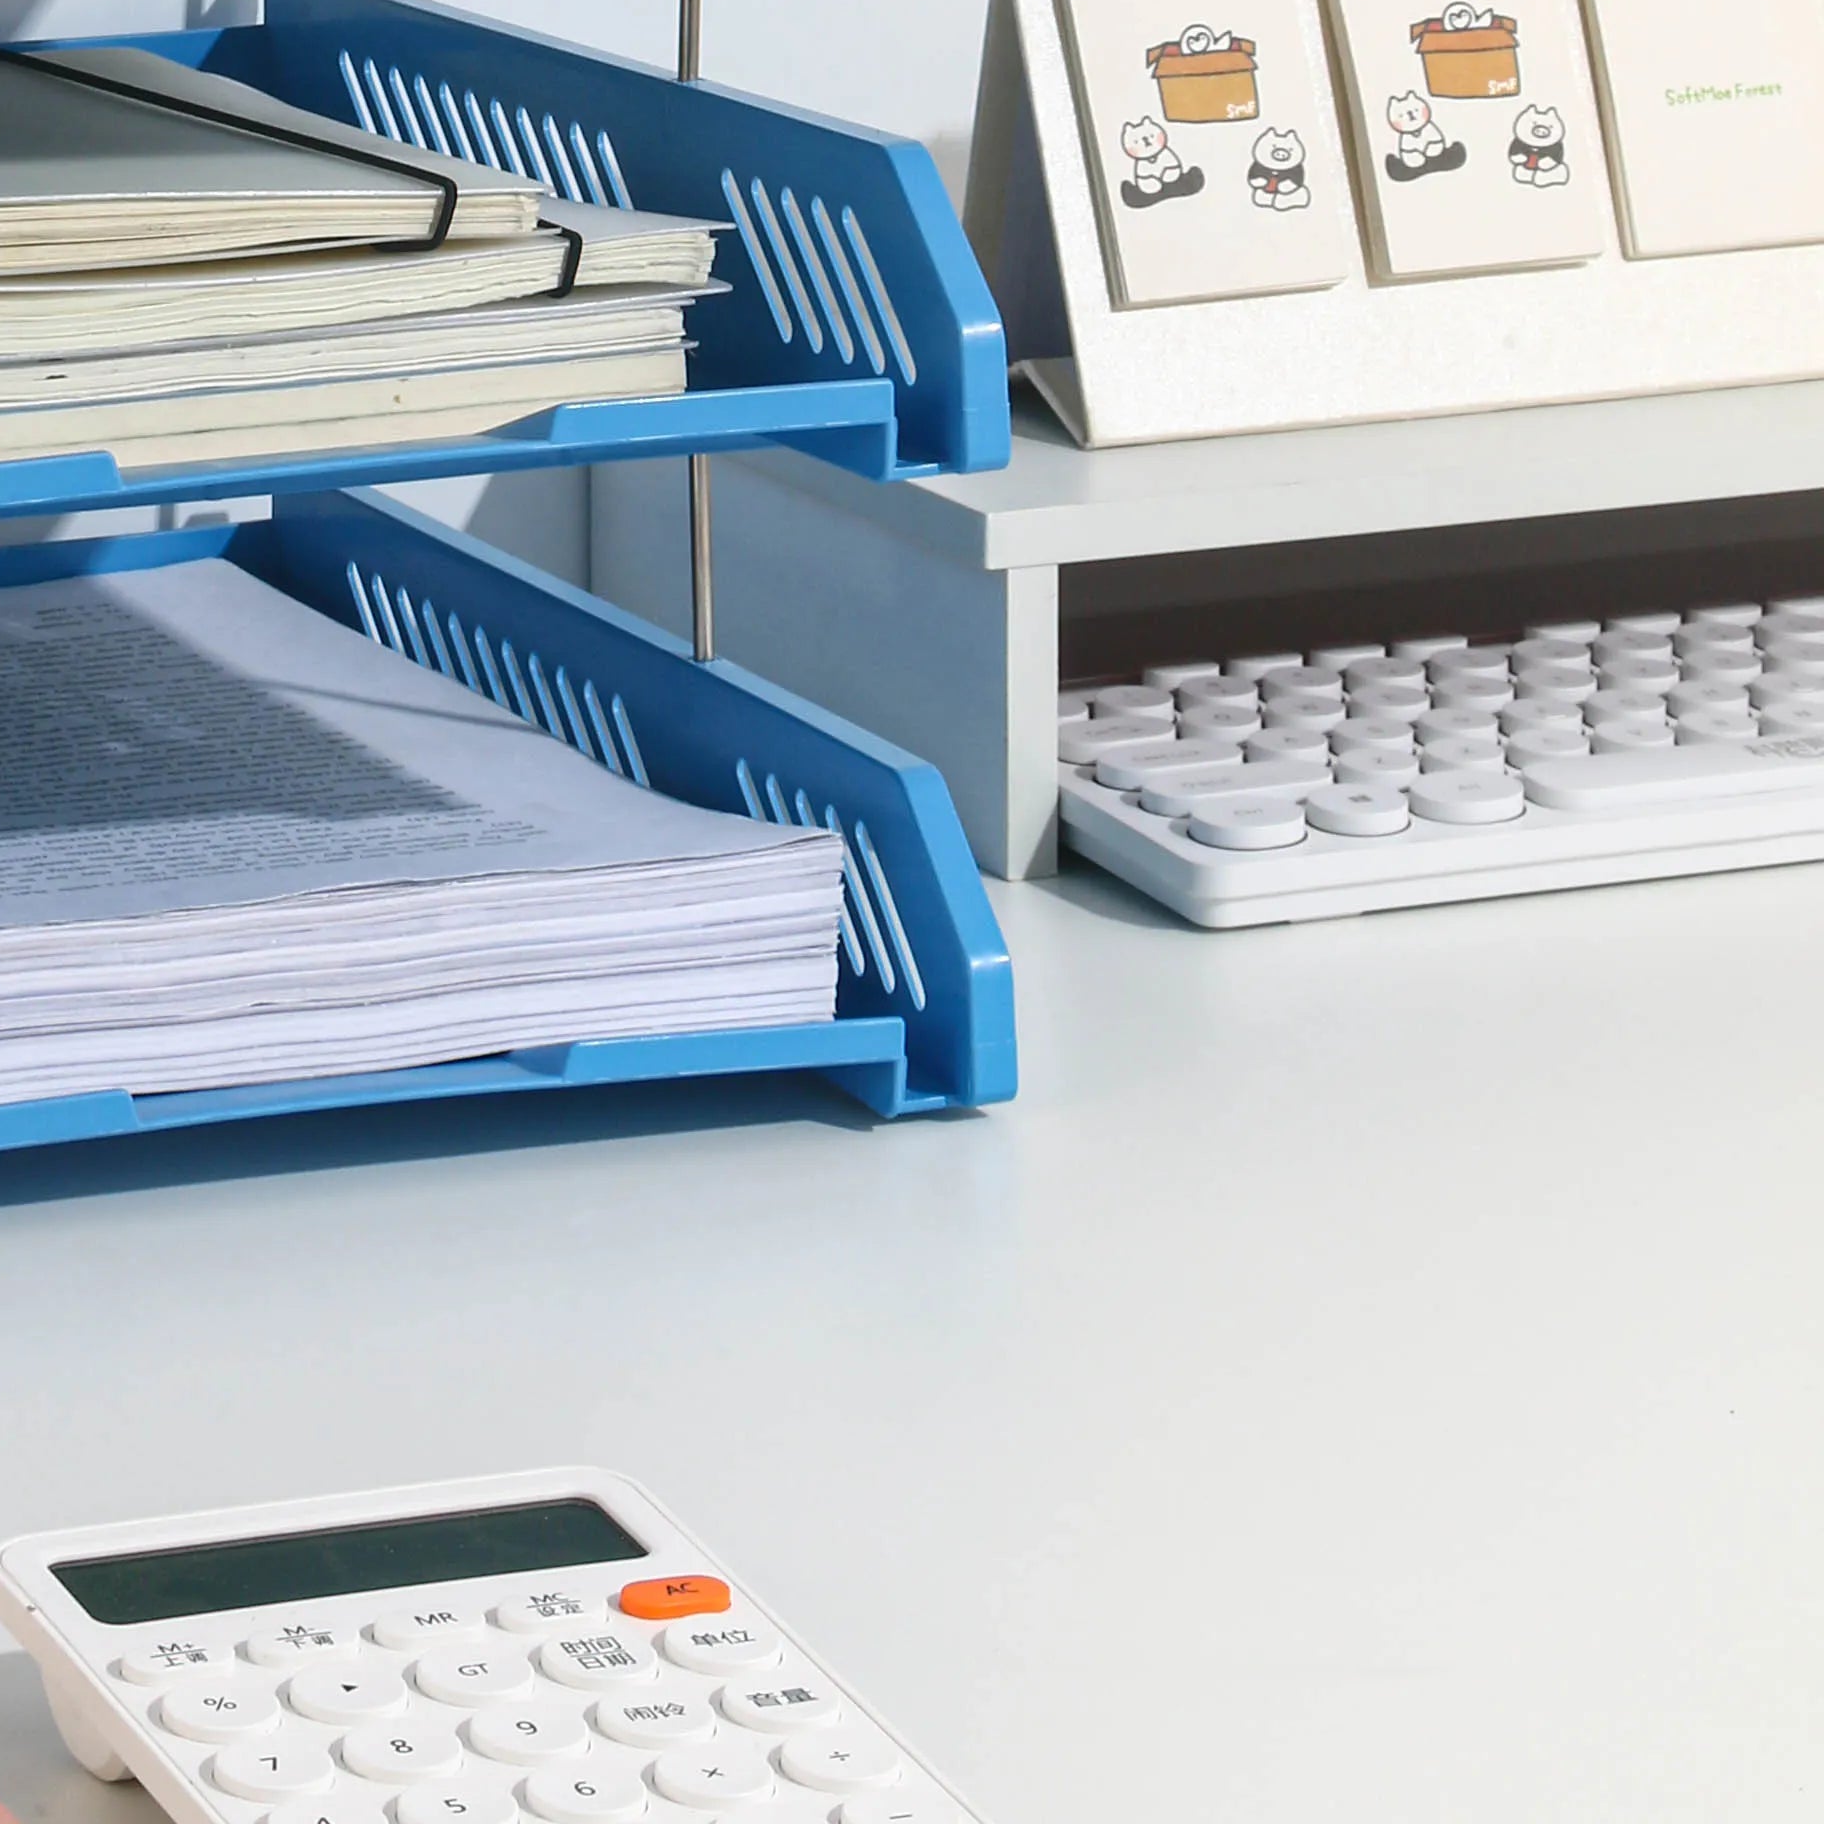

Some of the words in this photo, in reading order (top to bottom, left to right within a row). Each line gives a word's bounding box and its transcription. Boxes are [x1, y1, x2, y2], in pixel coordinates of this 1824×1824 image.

[1734, 82, 1782, 100] Forest
[665, 1582, 700, 1596] AC
[529, 1592, 568, 1605] MC
[413, 1611, 458, 1627] MR
[560, 1636, 622, 1654] 时间
[690, 1629, 757, 1647] 单位
[577, 1651, 637, 1670] 日期
[458, 1662, 490, 1677] GT
[203, 1695, 238, 1713] %
[745, 1687, 818, 1708] 音量
[516, 1719, 538, 1737] 9
[390, 1738, 414, 1755] 8
[260, 1756, 279, 1773] 7
[575, 1781, 596, 1796] 6
[444, 1797, 467, 1814] 5
